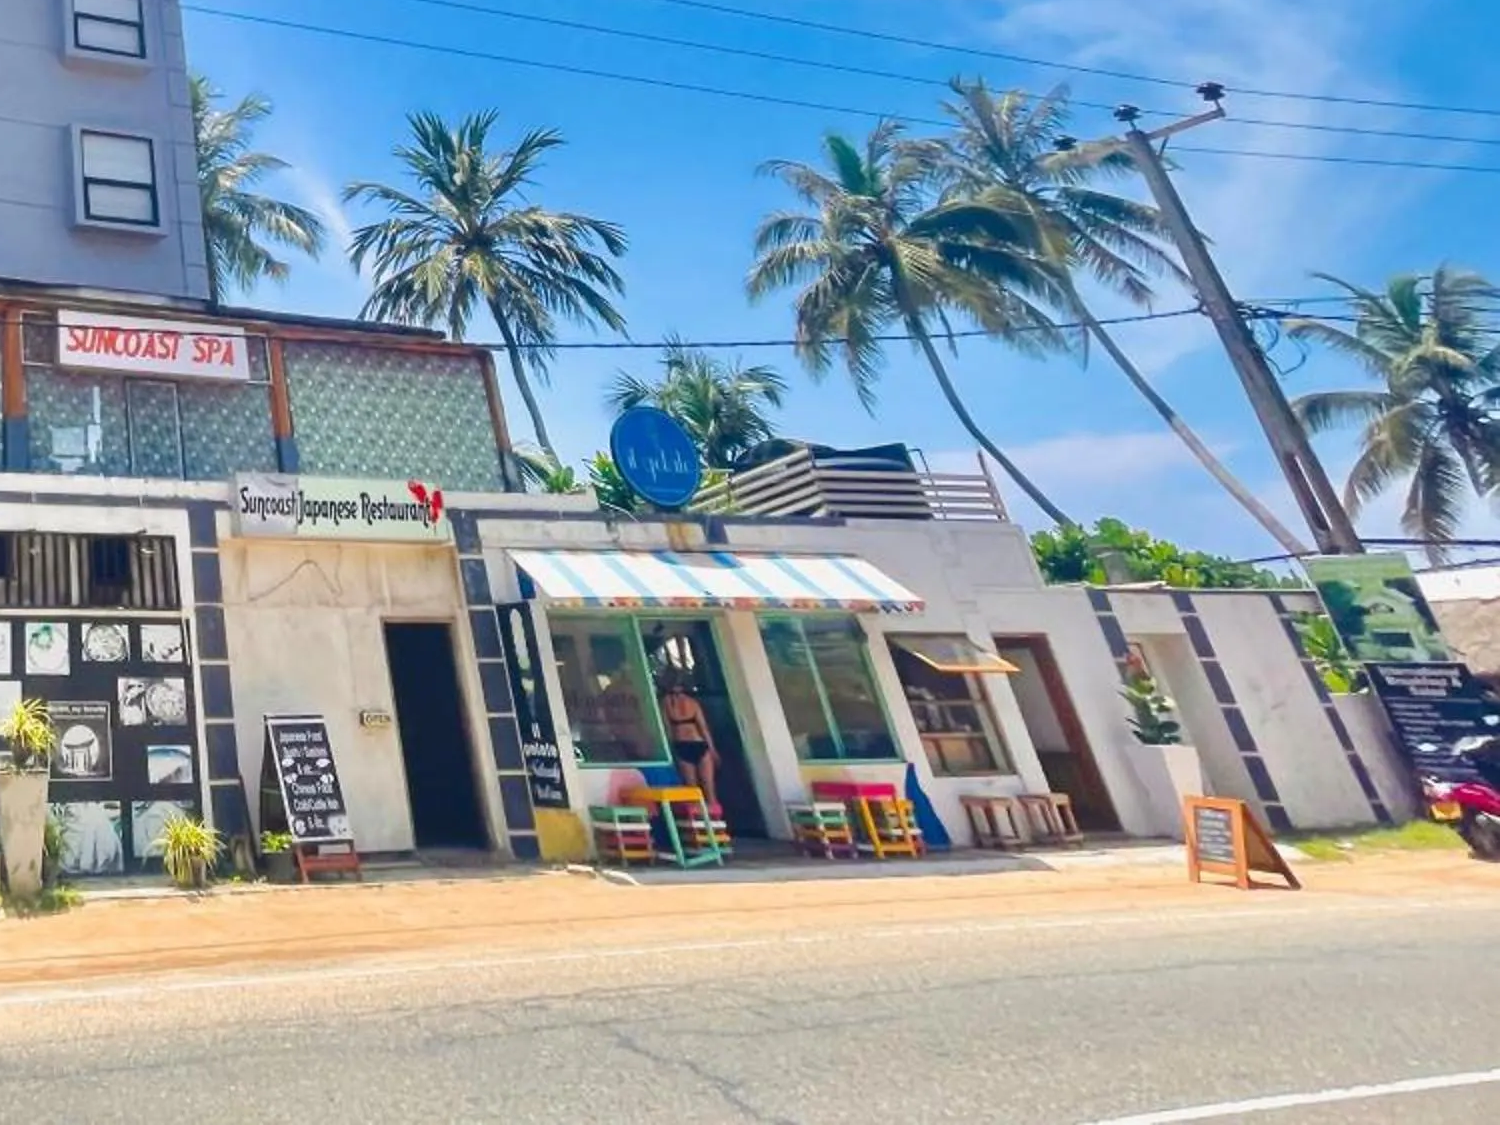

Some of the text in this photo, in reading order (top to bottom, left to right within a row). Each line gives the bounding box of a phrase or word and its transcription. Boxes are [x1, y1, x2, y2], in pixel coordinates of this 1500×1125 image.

[66, 326, 235, 366] SUNCOAST SPA
[240, 486, 432, 528] Suncoast Japanese Restaurant
